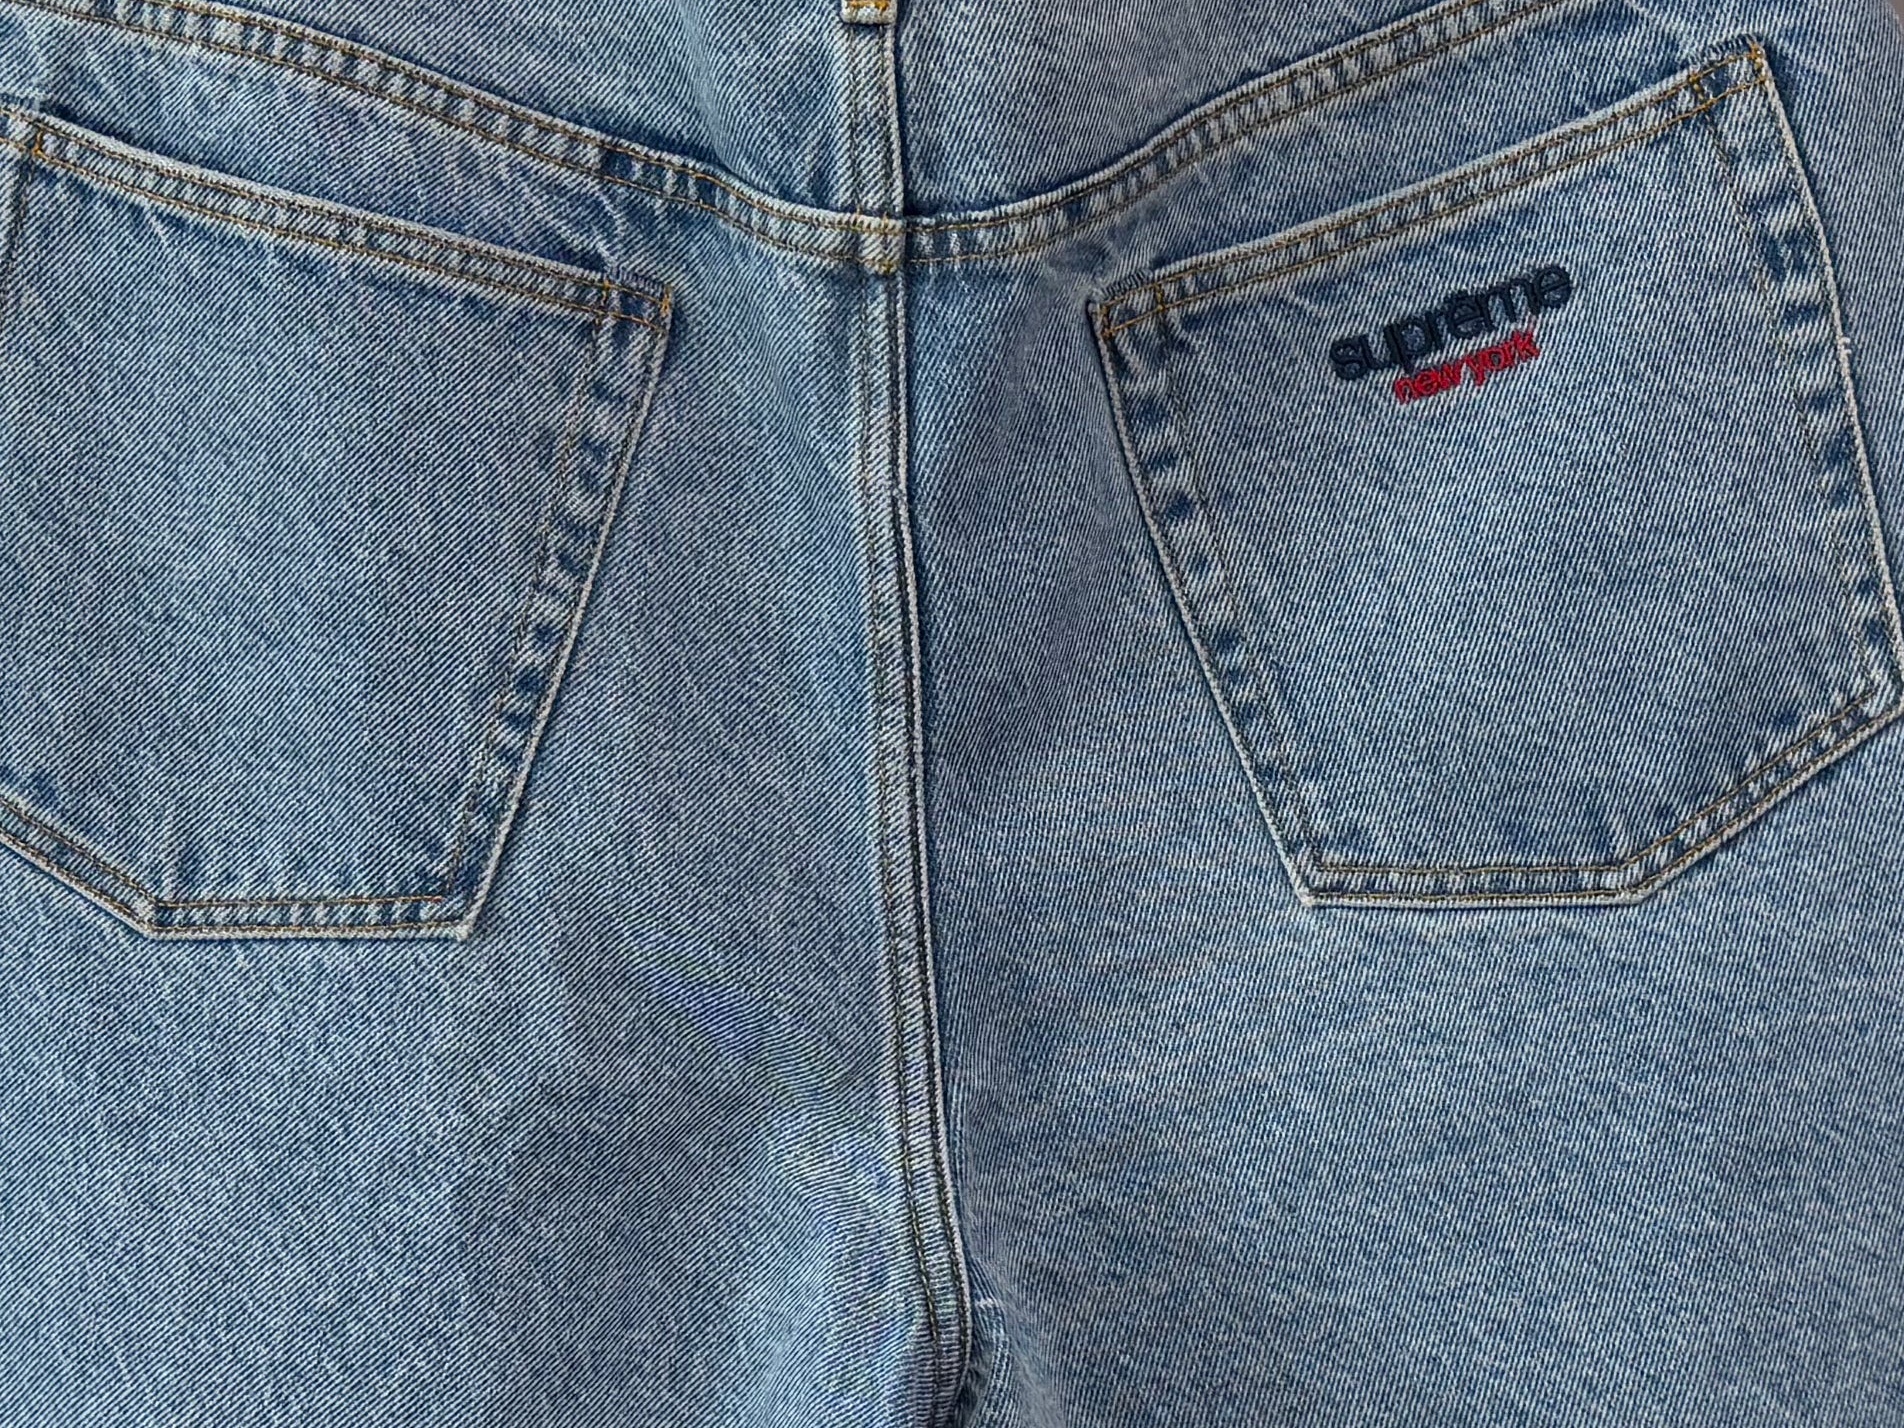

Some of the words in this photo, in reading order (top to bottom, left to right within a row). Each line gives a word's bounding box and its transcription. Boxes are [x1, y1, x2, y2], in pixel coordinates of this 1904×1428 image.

[1330, 265, 1572, 381] supreme
[1394, 362, 1463, 405] new
[1463, 325, 1541, 387] york
